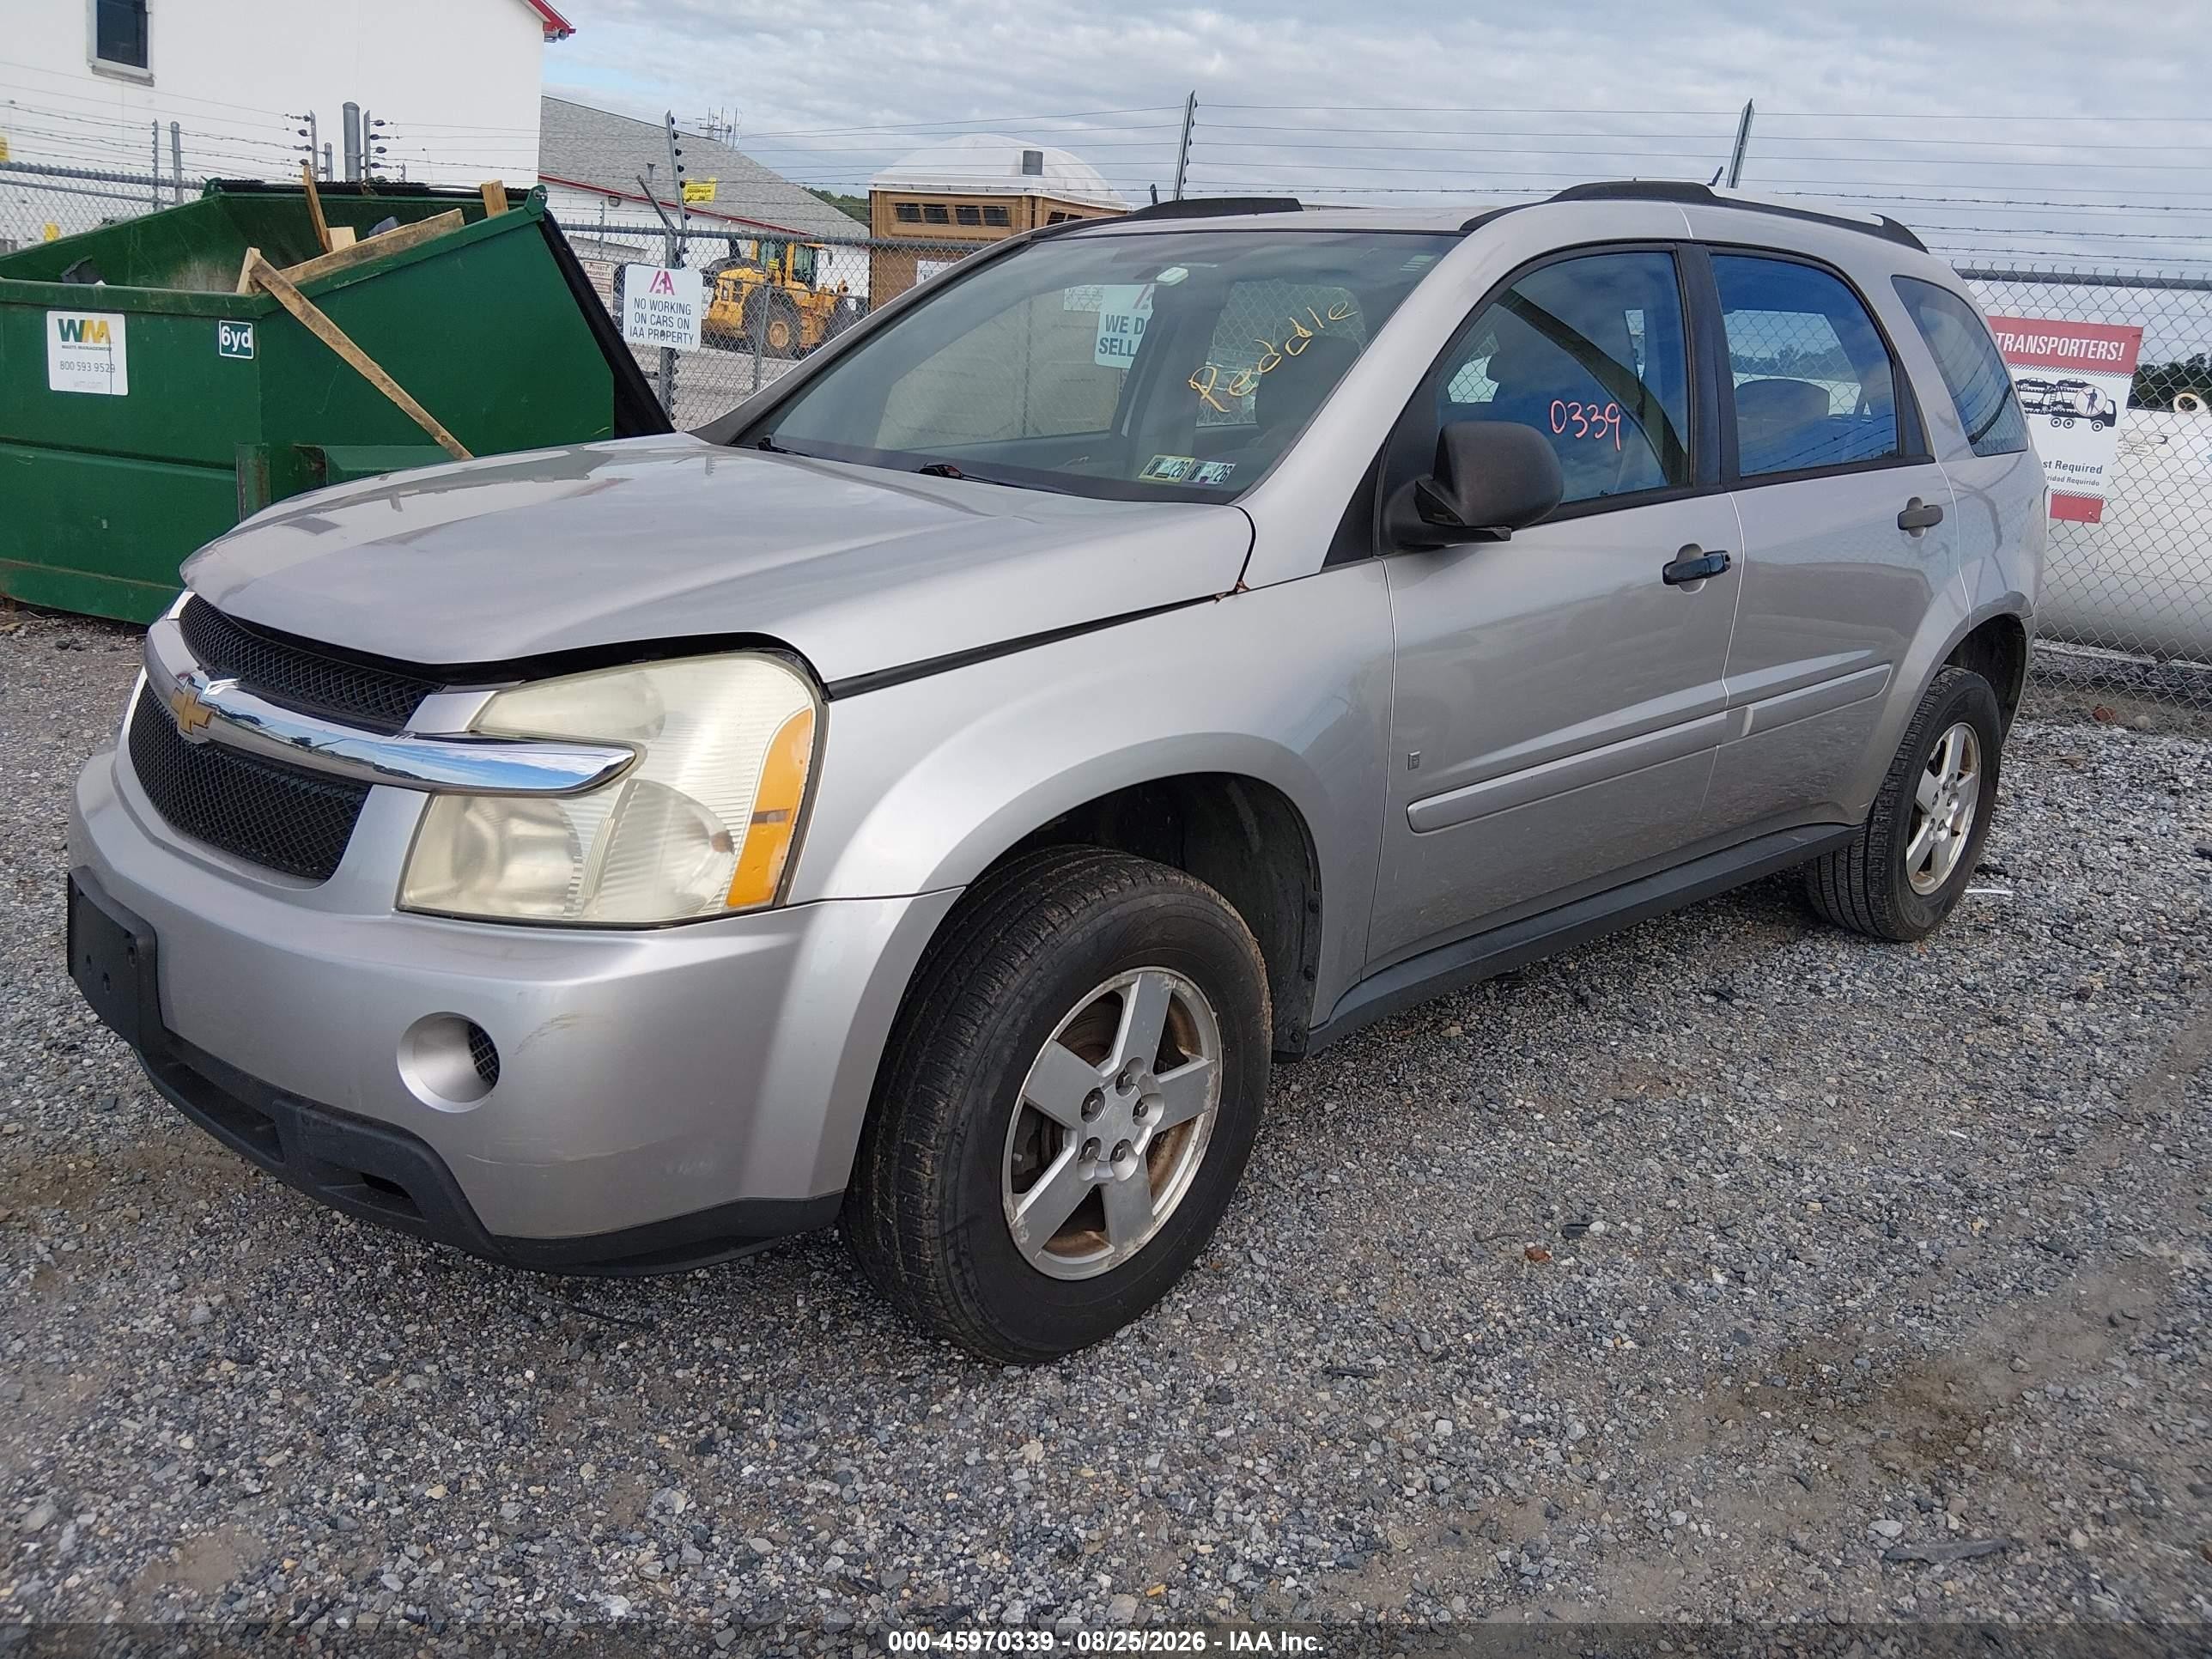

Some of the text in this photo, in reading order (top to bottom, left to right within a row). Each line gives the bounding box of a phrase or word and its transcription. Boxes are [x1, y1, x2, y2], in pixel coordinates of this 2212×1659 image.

[634, 298, 691, 315] NO WORKING
[57, 319, 111, 343] WM
[635, 312, 690, 330] ON CARS ON
[1105, 314, 1146, 335] WE D
[222, 325, 252, 351] 6yd
[629, 325, 694, 344] IAA PROPERTY
[1099, 337, 1136, 357] SELL
[1996, 332, 2125, 362] TRANSPORTERS!
[60, 361, 75, 370] 800
[76, 362, 92, 372] 593
[1550, 400, 1621, 451] 0339
[2043, 460, 2103, 474] st Required
